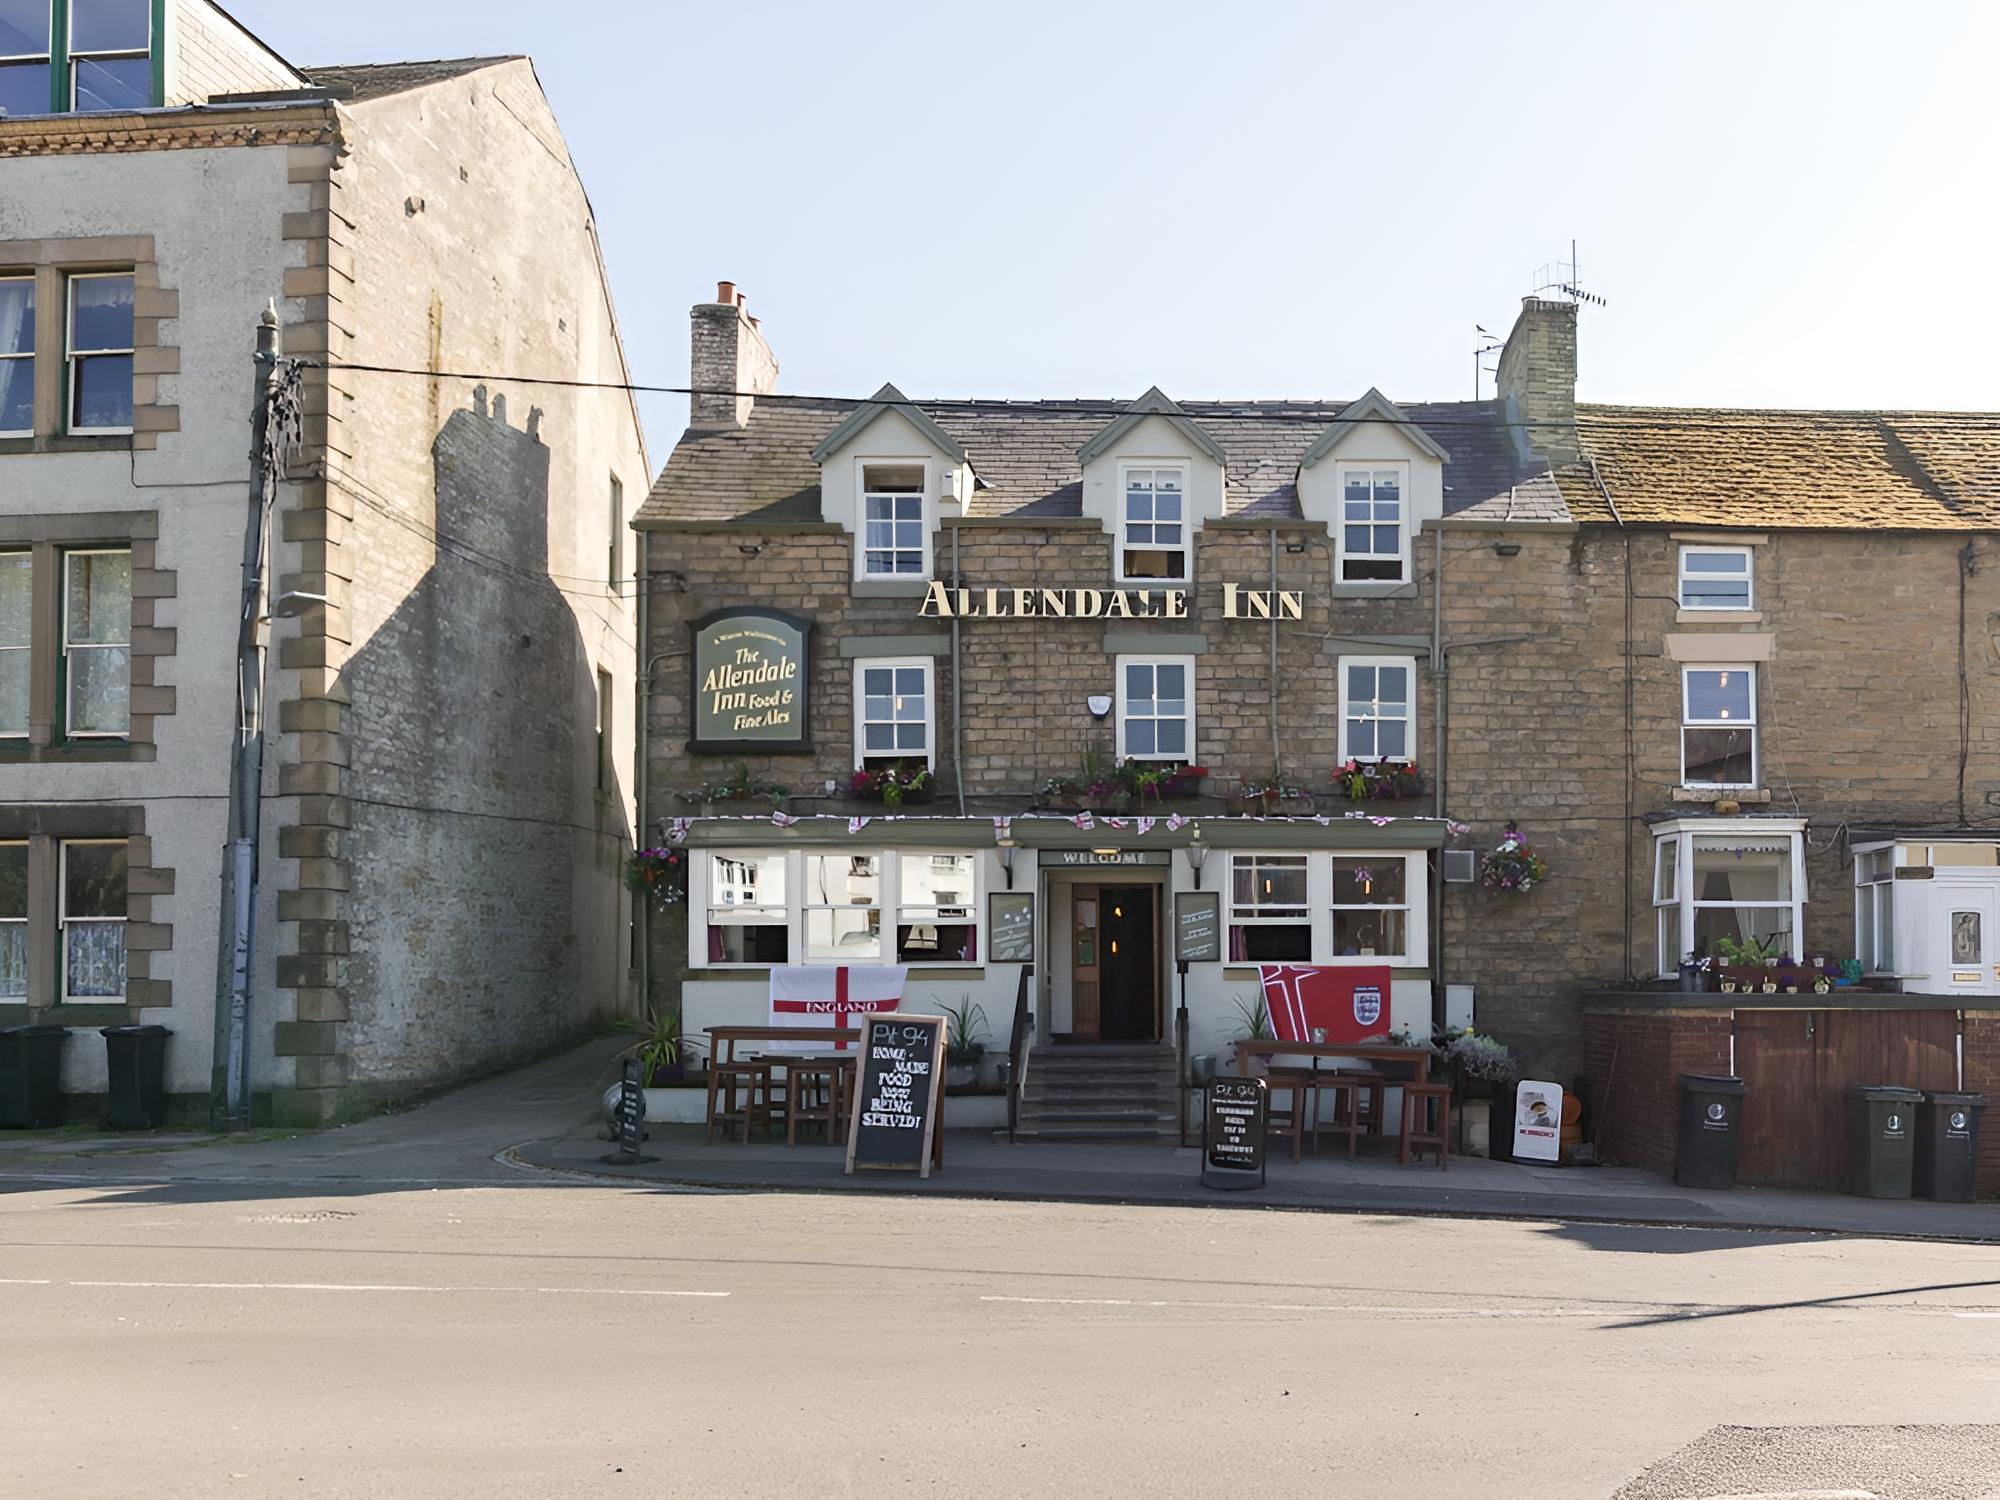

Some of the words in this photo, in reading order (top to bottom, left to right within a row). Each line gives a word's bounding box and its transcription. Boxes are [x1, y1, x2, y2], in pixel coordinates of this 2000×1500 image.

[917, 580, 1188, 618] ALLENDALE
[1222, 582, 1303, 620] INN
[736, 648, 759, 664] The
[703, 656, 796, 692] Allendale
[713, 691, 746, 714] Inn
[748, 690, 780, 709] Food
[781, 689, 793, 705] &
[734, 714, 763, 730] Fine
[762, 709, 790, 726] Ales
[806, 1002, 877, 1013] ENGLAND
